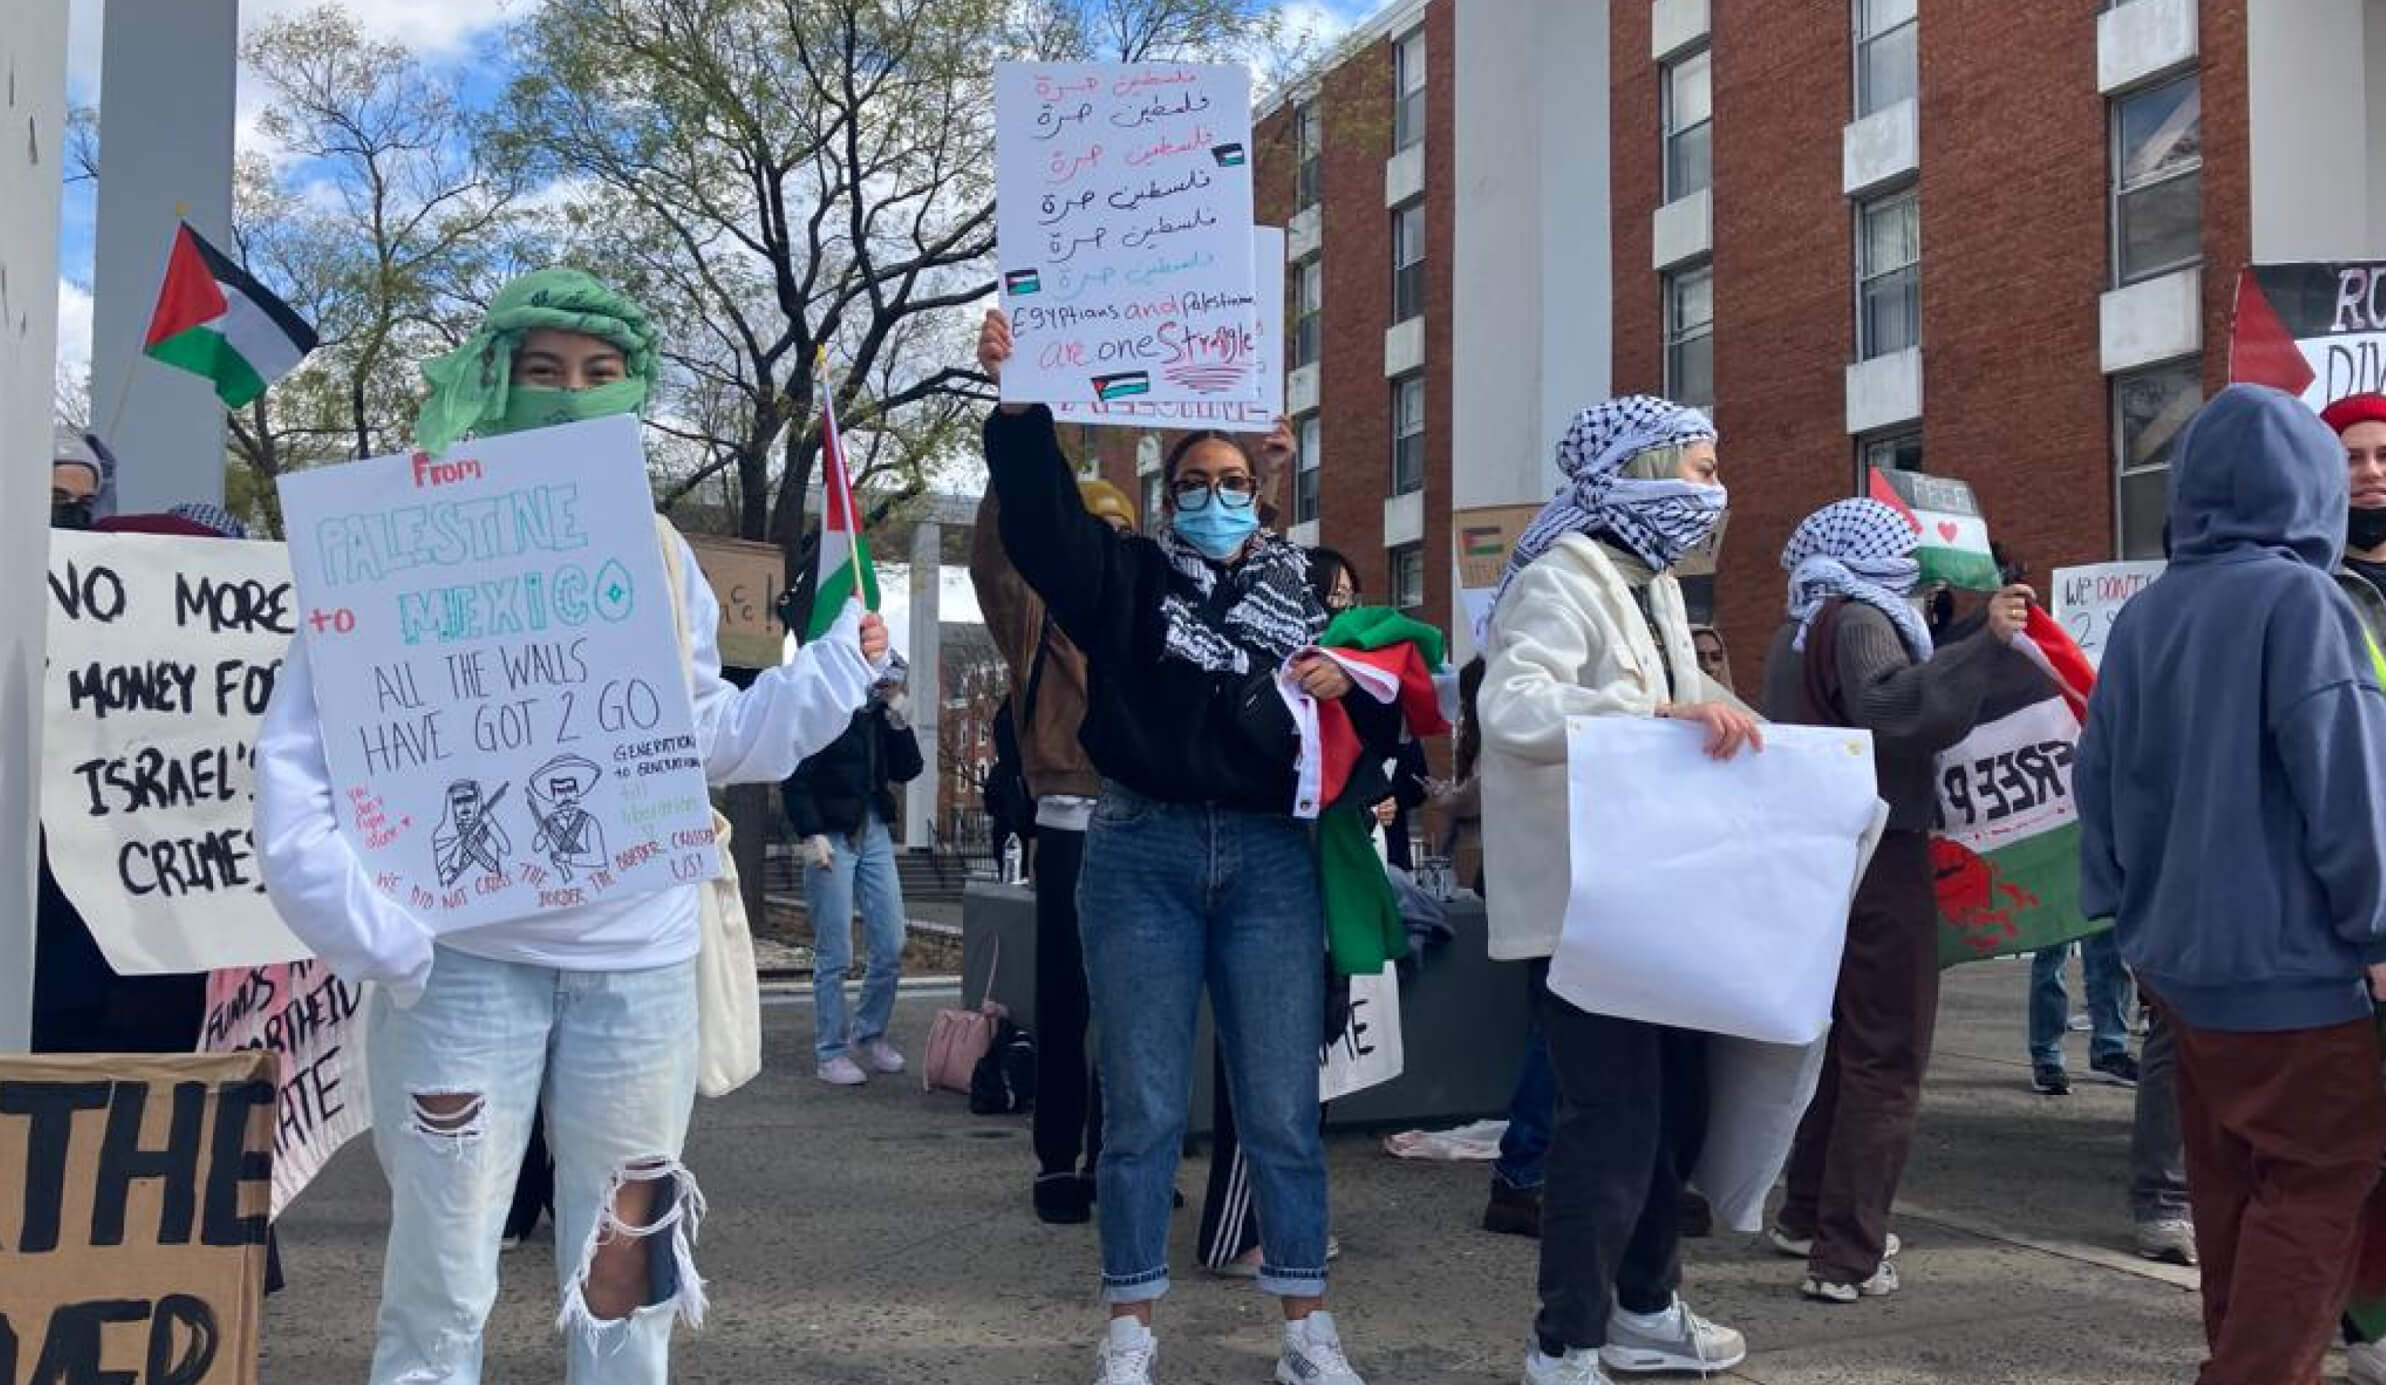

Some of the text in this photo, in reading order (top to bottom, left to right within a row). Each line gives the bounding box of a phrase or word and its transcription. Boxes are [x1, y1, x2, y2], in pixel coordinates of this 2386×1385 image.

[1012, 303, 1120, 338] Egyptians
[1124, 295, 1180, 320] and
[1039, 342, 1091, 369] are
[1098, 334, 1158, 359] one
[411, 451, 482, 488] From
[315, 481, 589, 586] PALESTINE
[175, 572, 297, 635] MORE
[309, 607, 356, 635] to
[68, 660, 197, 718] MONEY
[374, 636, 589, 713] ALL THE WALLS
[359, 677, 661, 776] HAVE GOT 2 GO
[73, 743, 256, 816] ISRAEL'
[0, 1080, 277, 1253] THE
